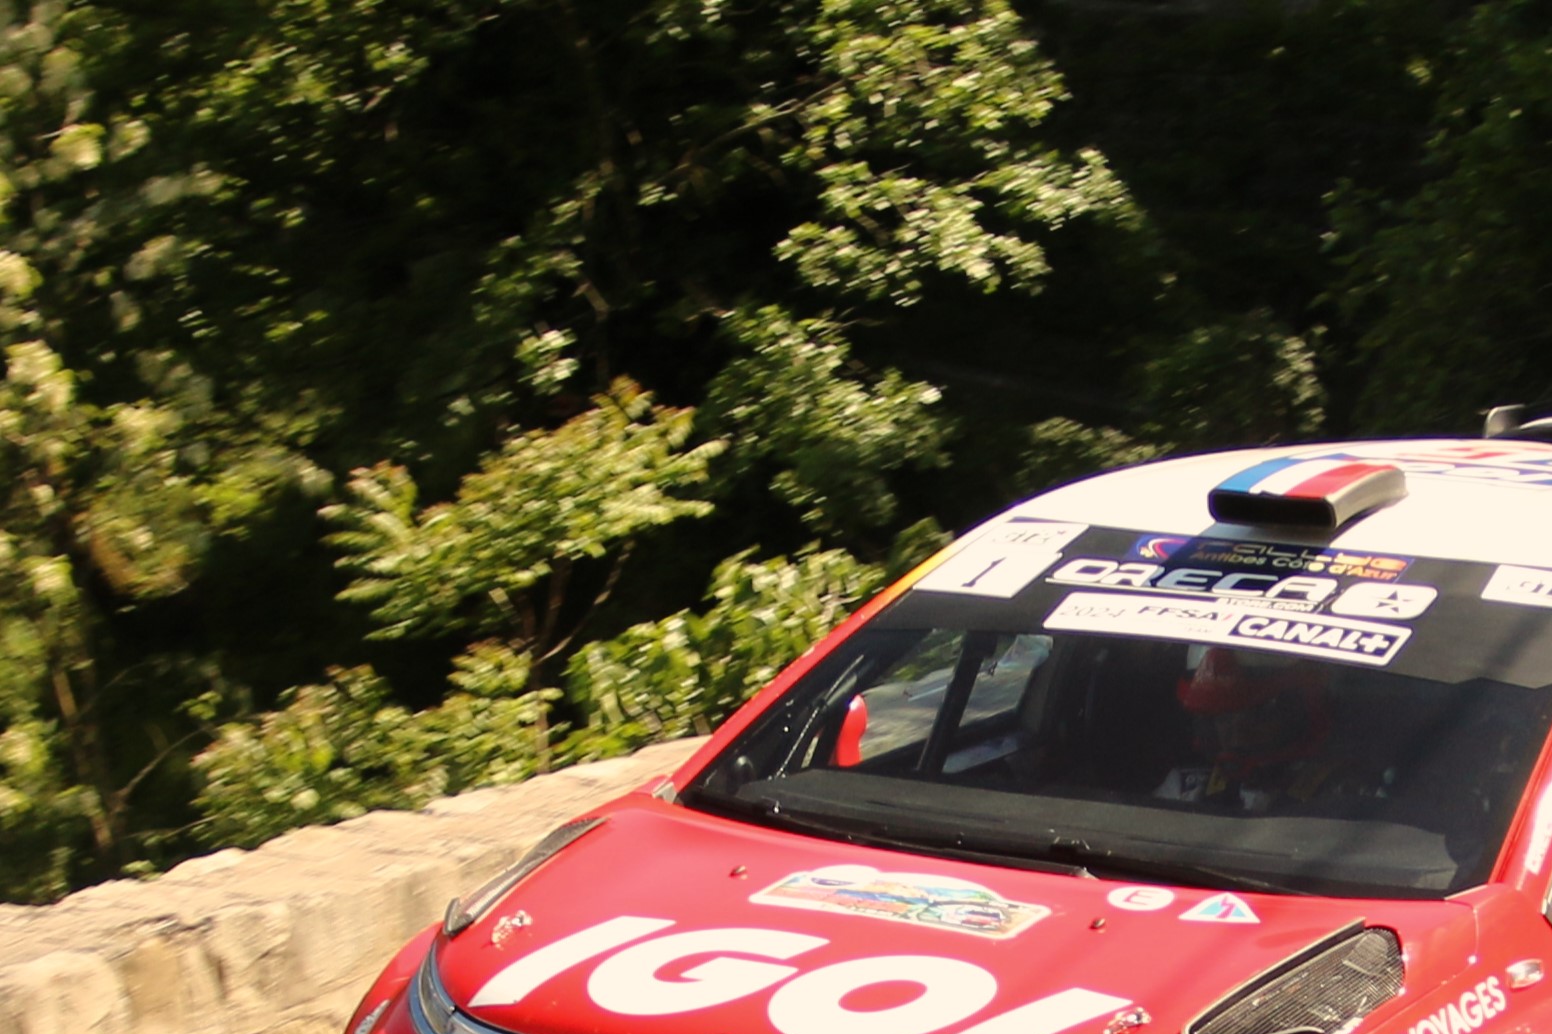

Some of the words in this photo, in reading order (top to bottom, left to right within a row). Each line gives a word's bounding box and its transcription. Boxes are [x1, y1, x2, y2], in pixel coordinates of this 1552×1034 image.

[1052, 557, 1339, 600] ORECA
[1137, 604, 1221, 622] FFSA
[1237, 616, 1391, 654] CANAL+
